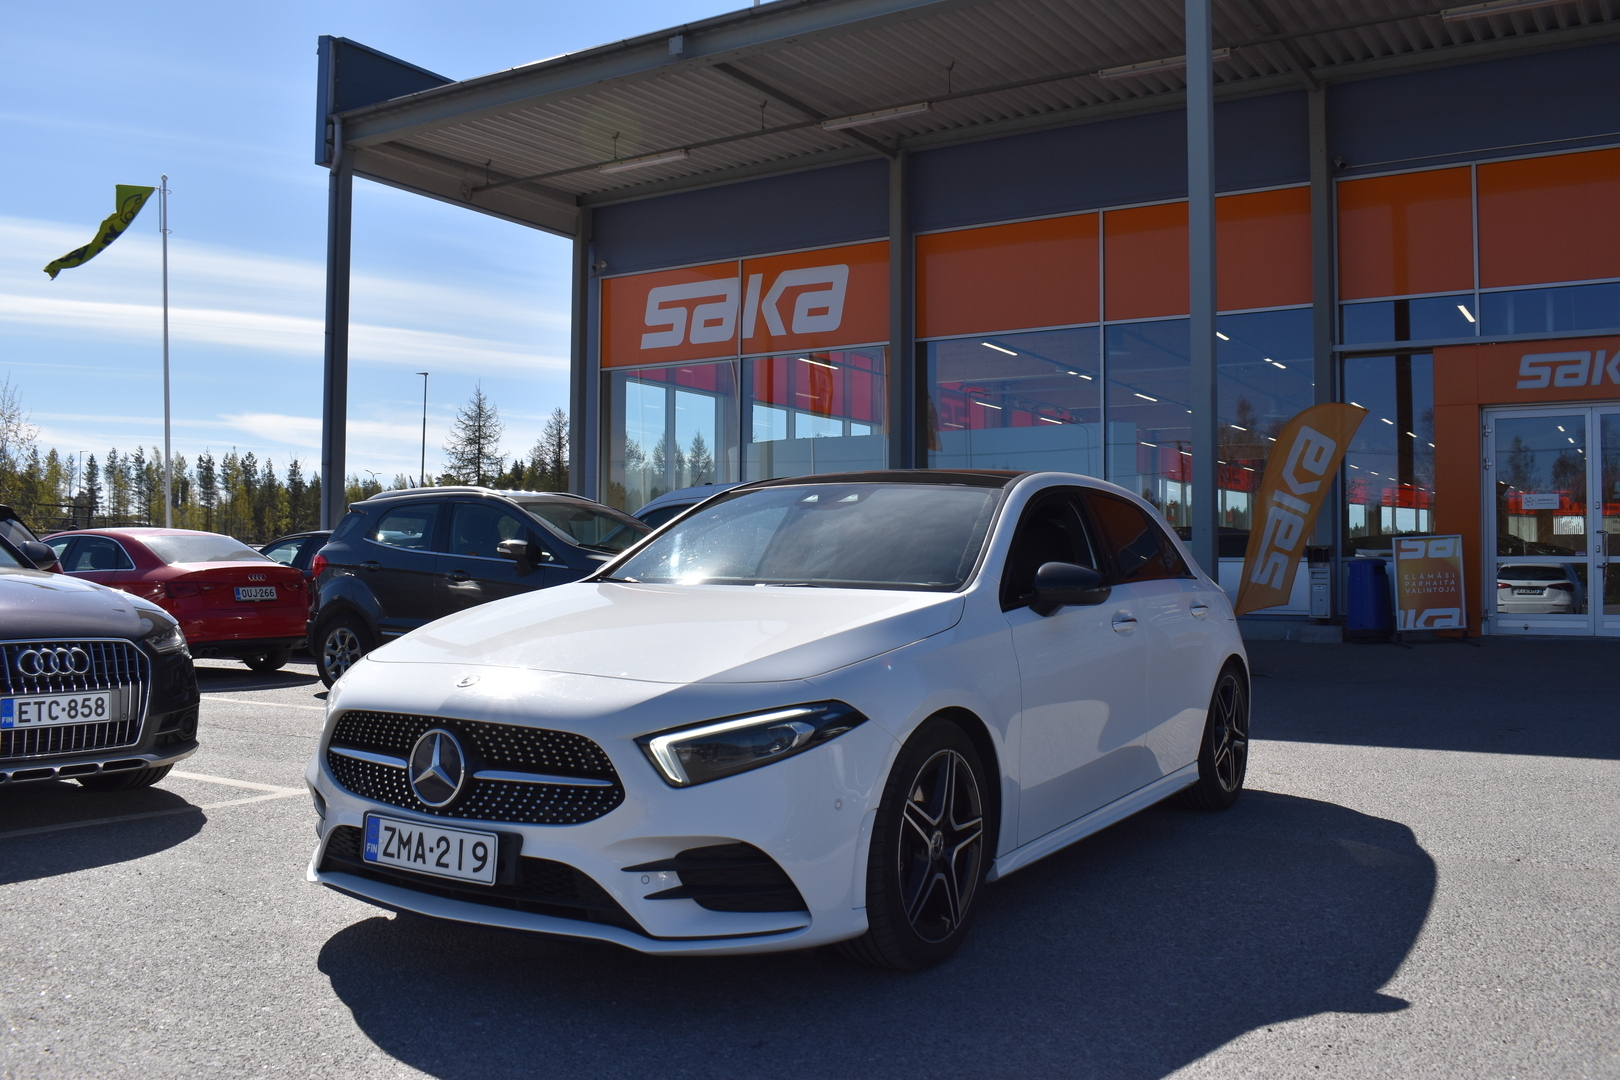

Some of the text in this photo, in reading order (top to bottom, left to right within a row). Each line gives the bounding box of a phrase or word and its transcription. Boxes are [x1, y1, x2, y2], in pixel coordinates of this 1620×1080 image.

[1404, 571, 1455, 580] ELÄMÄSI
[1404, 579, 1455, 587] PARHAITA
[241, 589, 275, 598] OUJ-266
[18, 697, 105, 723] ETC-858
[366, 826, 488, 873] FIN ZMA-219
